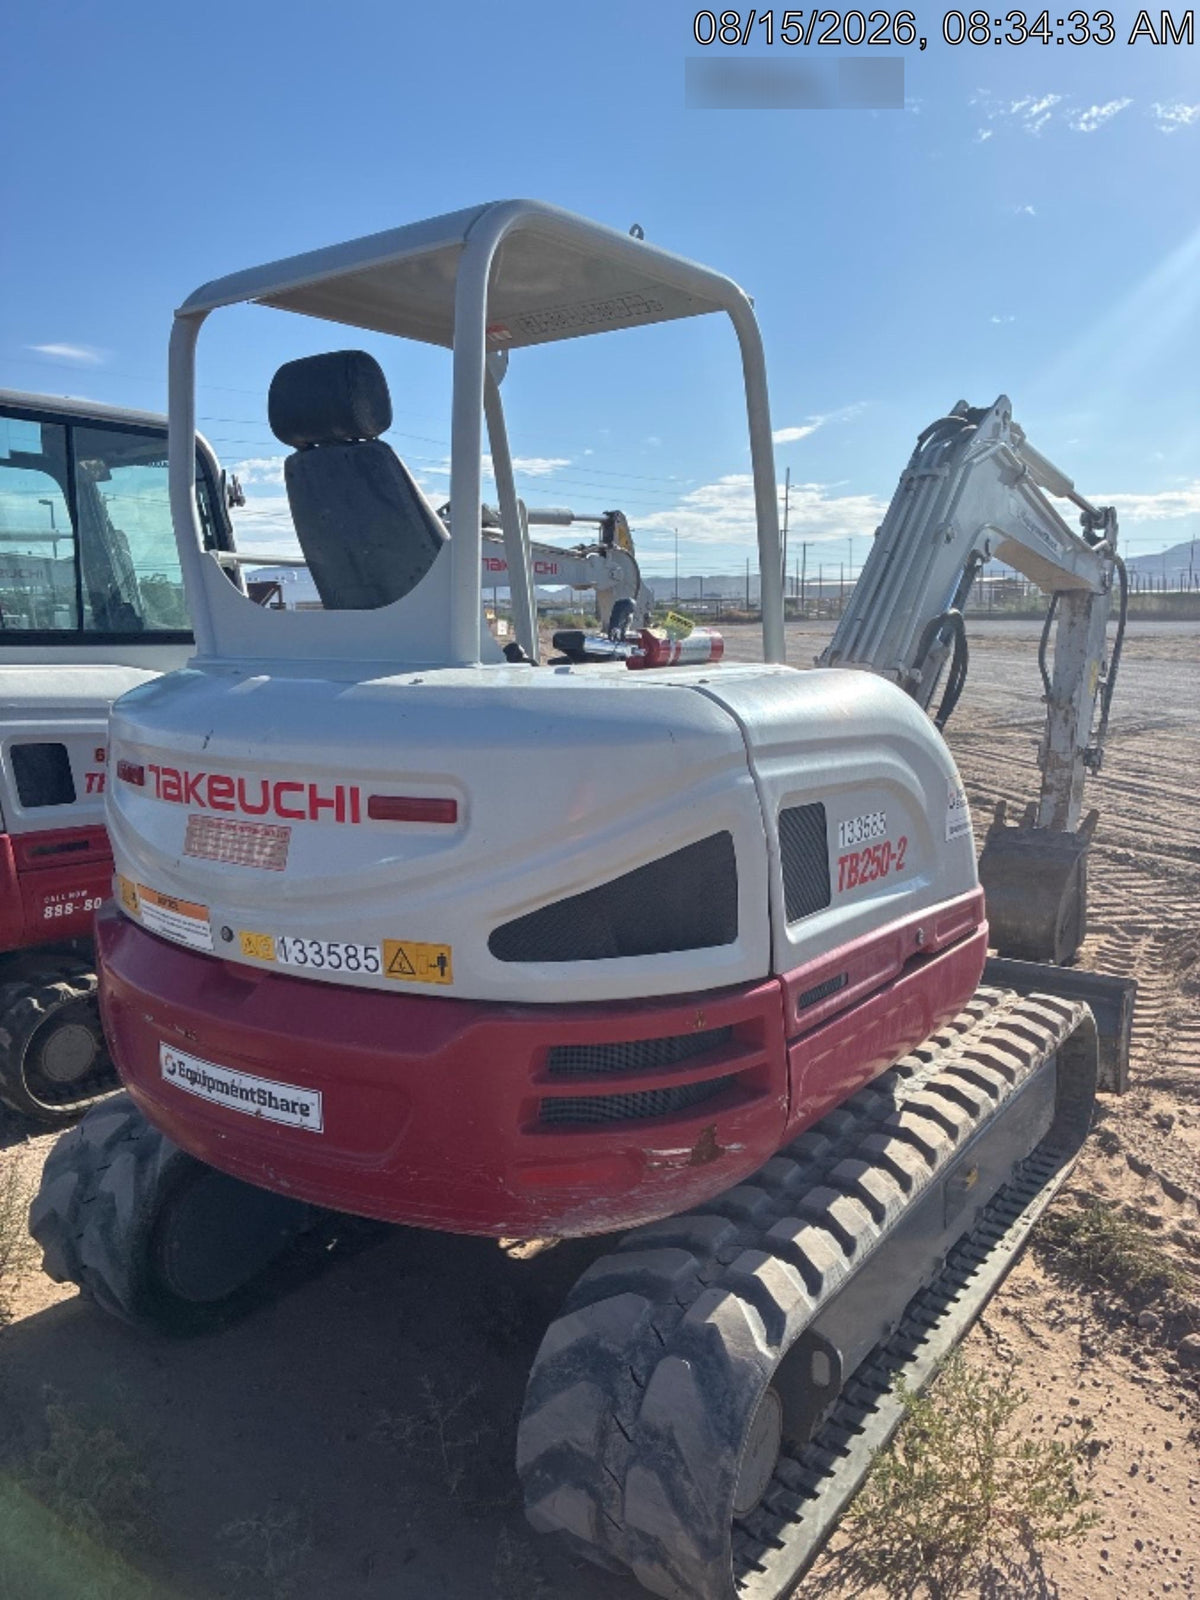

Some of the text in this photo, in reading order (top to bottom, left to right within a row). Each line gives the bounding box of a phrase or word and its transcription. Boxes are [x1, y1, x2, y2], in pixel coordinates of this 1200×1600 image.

[840, 811, 887, 847] 133585
[837, 835, 909, 893] TB250-2
[279, 935, 380, 974] 133585
[177, 1060, 311, 1118] EquipmentShare
